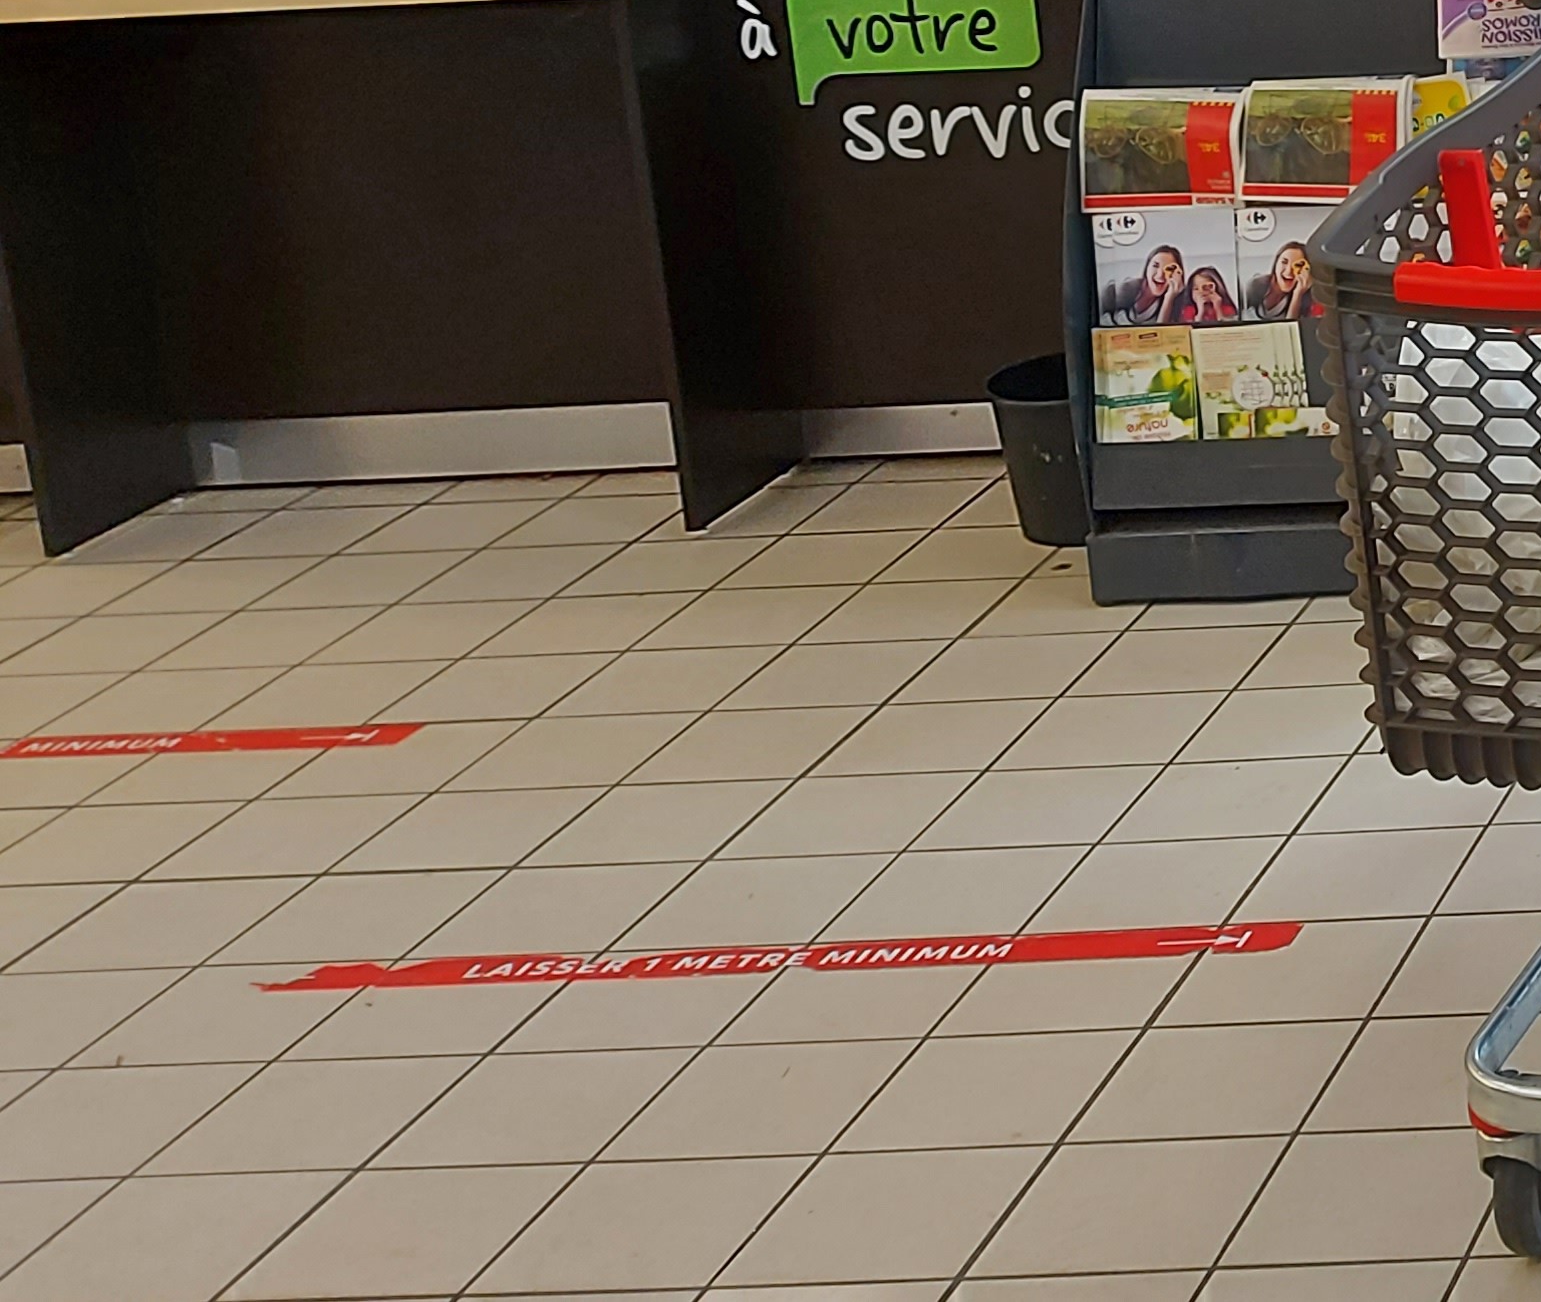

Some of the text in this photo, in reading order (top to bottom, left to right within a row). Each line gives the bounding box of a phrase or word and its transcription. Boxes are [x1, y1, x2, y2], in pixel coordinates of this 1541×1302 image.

[843, 85, 1075, 161] servic
[20, 737, 183, 754] MINIMUM
[462, 942, 1014, 980] LAISSER 1 METRE MINIMUM
